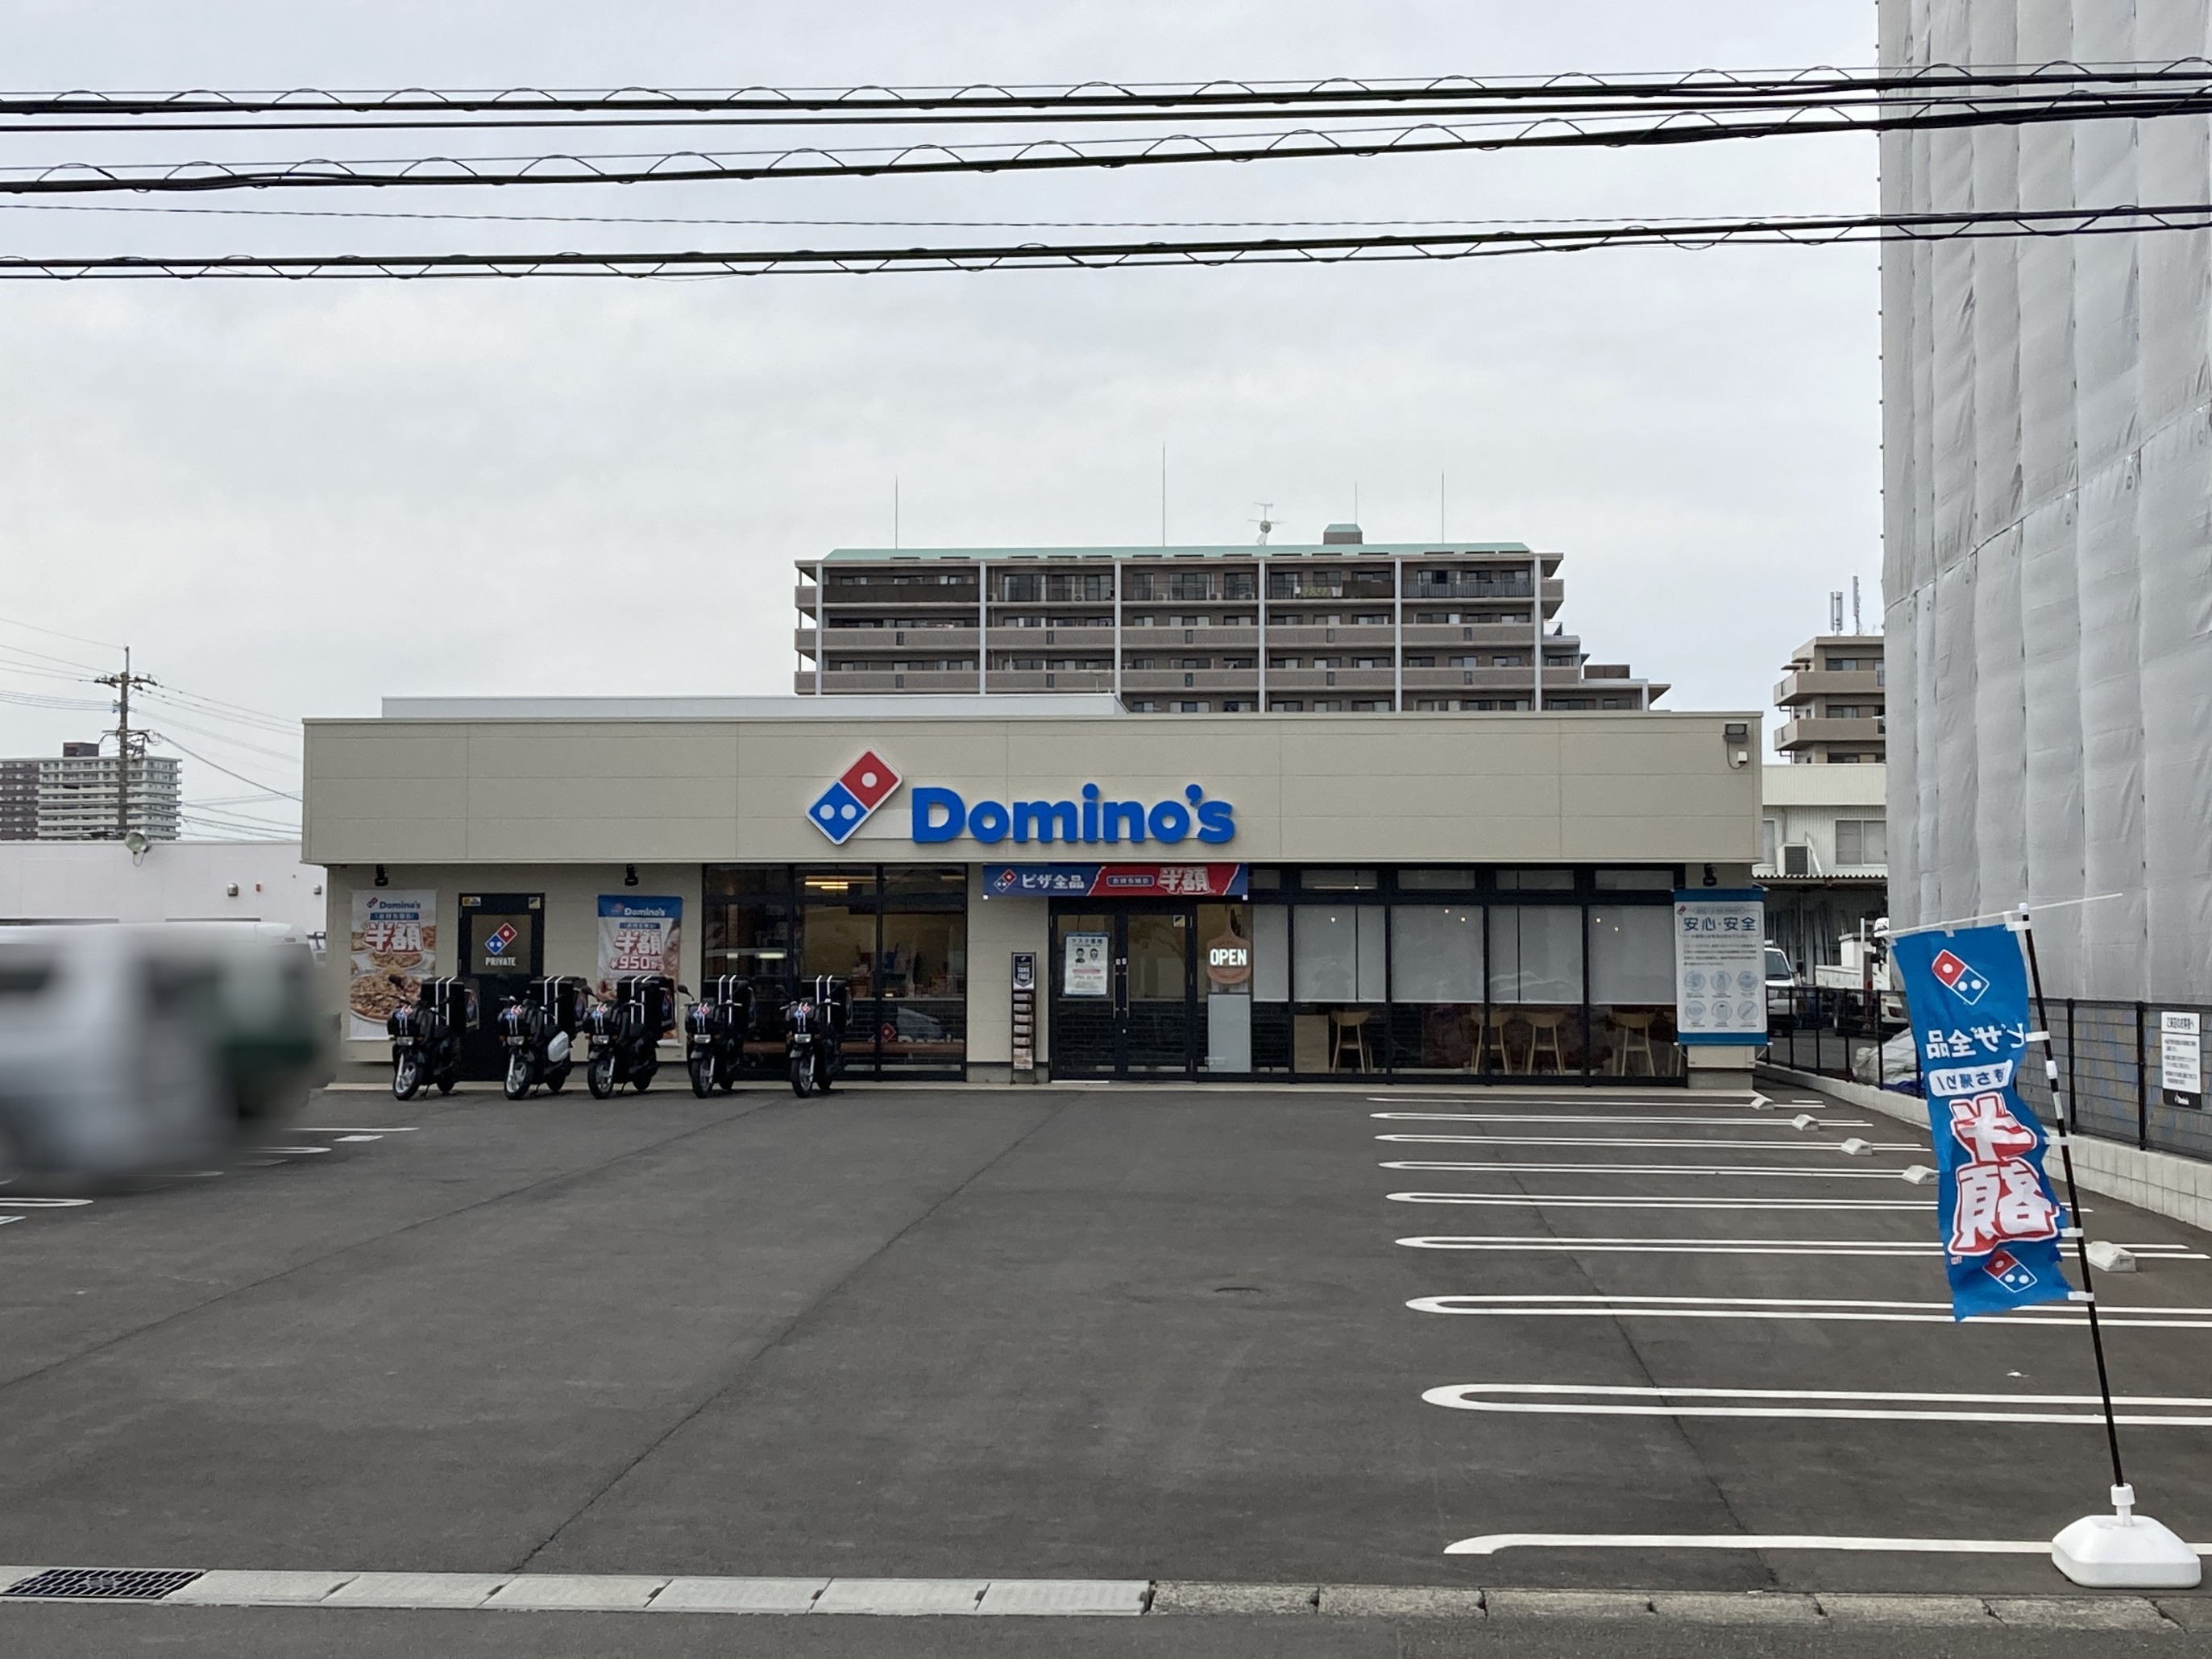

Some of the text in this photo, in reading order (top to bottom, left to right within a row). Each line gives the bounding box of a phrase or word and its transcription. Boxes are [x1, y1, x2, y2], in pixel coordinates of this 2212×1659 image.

[911, 783, 1235, 844] Domino's
[1022, 874, 1085, 890] ピザ全品
[1159, 868, 1210, 893] 半額
[379, 900, 421, 910] Domino's
[624, 906, 666, 916] Domino's
[1683, 916, 1757, 931] 安心・安全
[364, 921, 422, 952] 半額
[615, 930, 662, 956] 半額
[485, 957, 517, 966] PRIVATE
[1210, 948, 1247, 966] OPEN
